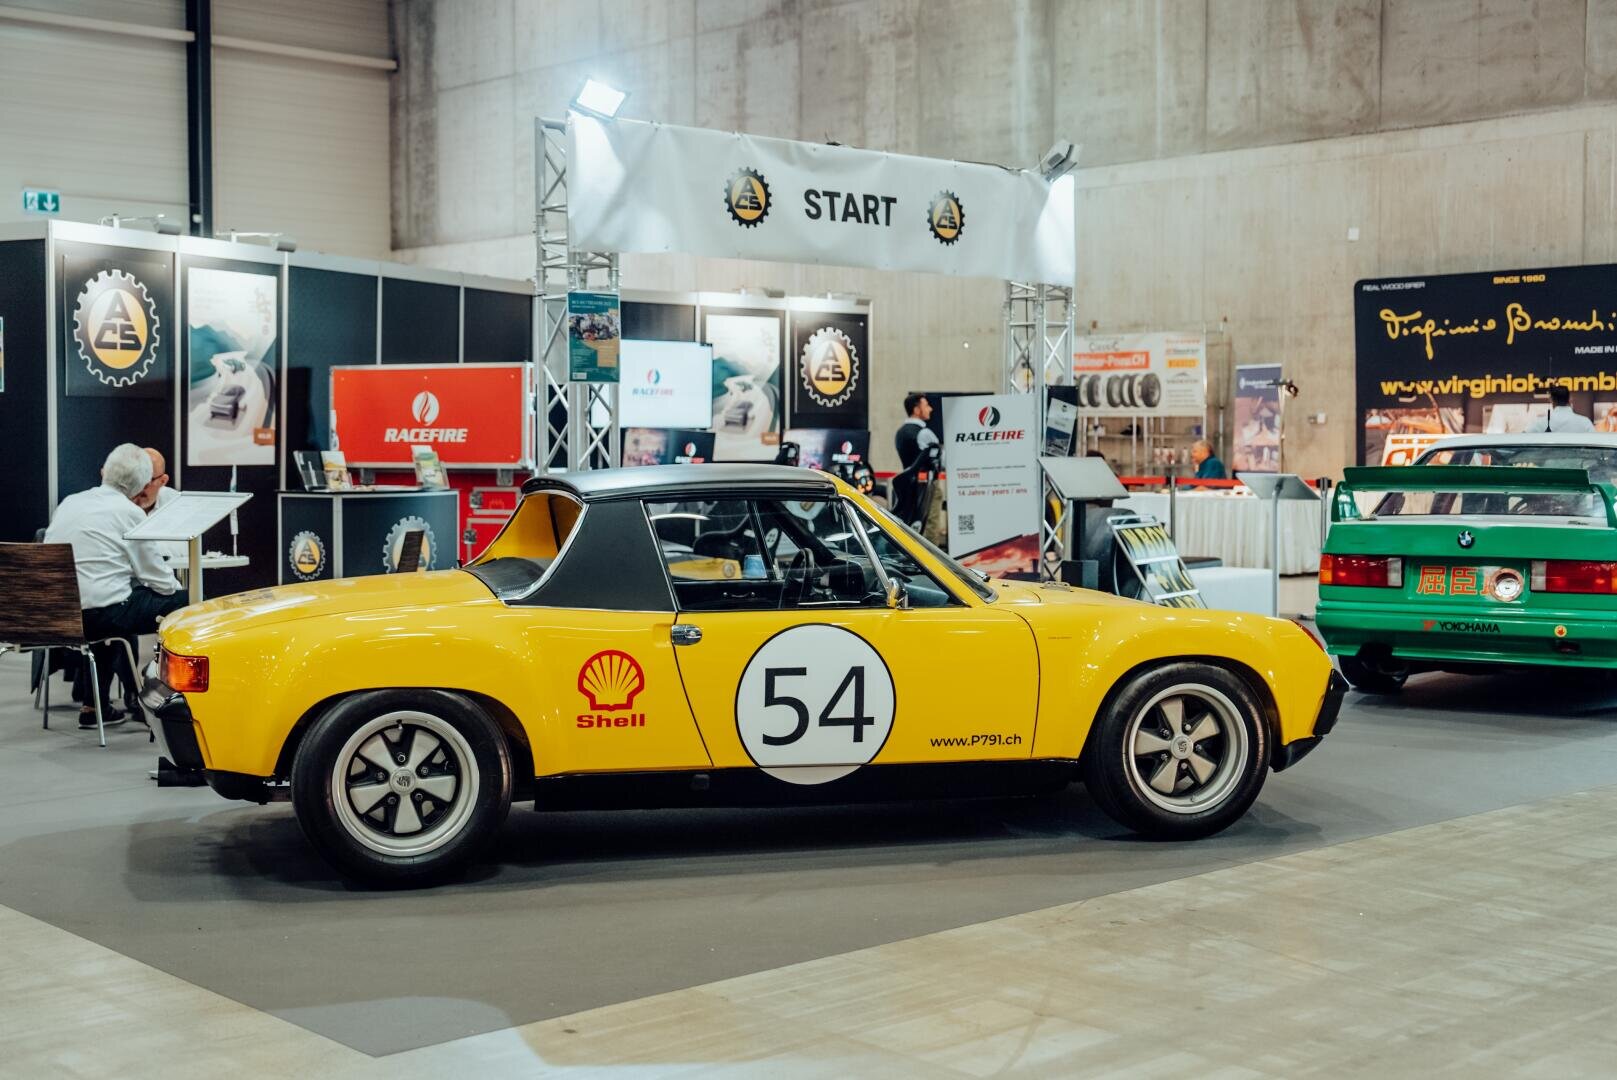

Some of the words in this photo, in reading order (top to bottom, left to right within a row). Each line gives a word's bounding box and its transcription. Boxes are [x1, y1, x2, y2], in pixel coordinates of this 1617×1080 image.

[804, 189, 897, 226] START
[1493, 275, 1520, 284] SINCE
[1574, 346, 1603, 354] MADE
[1604, 345, 1615, 353] IN
[632, 388, 674, 396] RACEFIRE
[384, 428, 468, 443] RACEFIRE
[955, 429, 1025, 442] RACEFIRE
[992, 489, 1009, 497] years
[1439, 621, 1500, 633] YOKOHAMA
[762, 665, 875, 746] 54
[576, 713, 645, 728] Shell
[930, 734, 1022, 747] www.P791.ch
